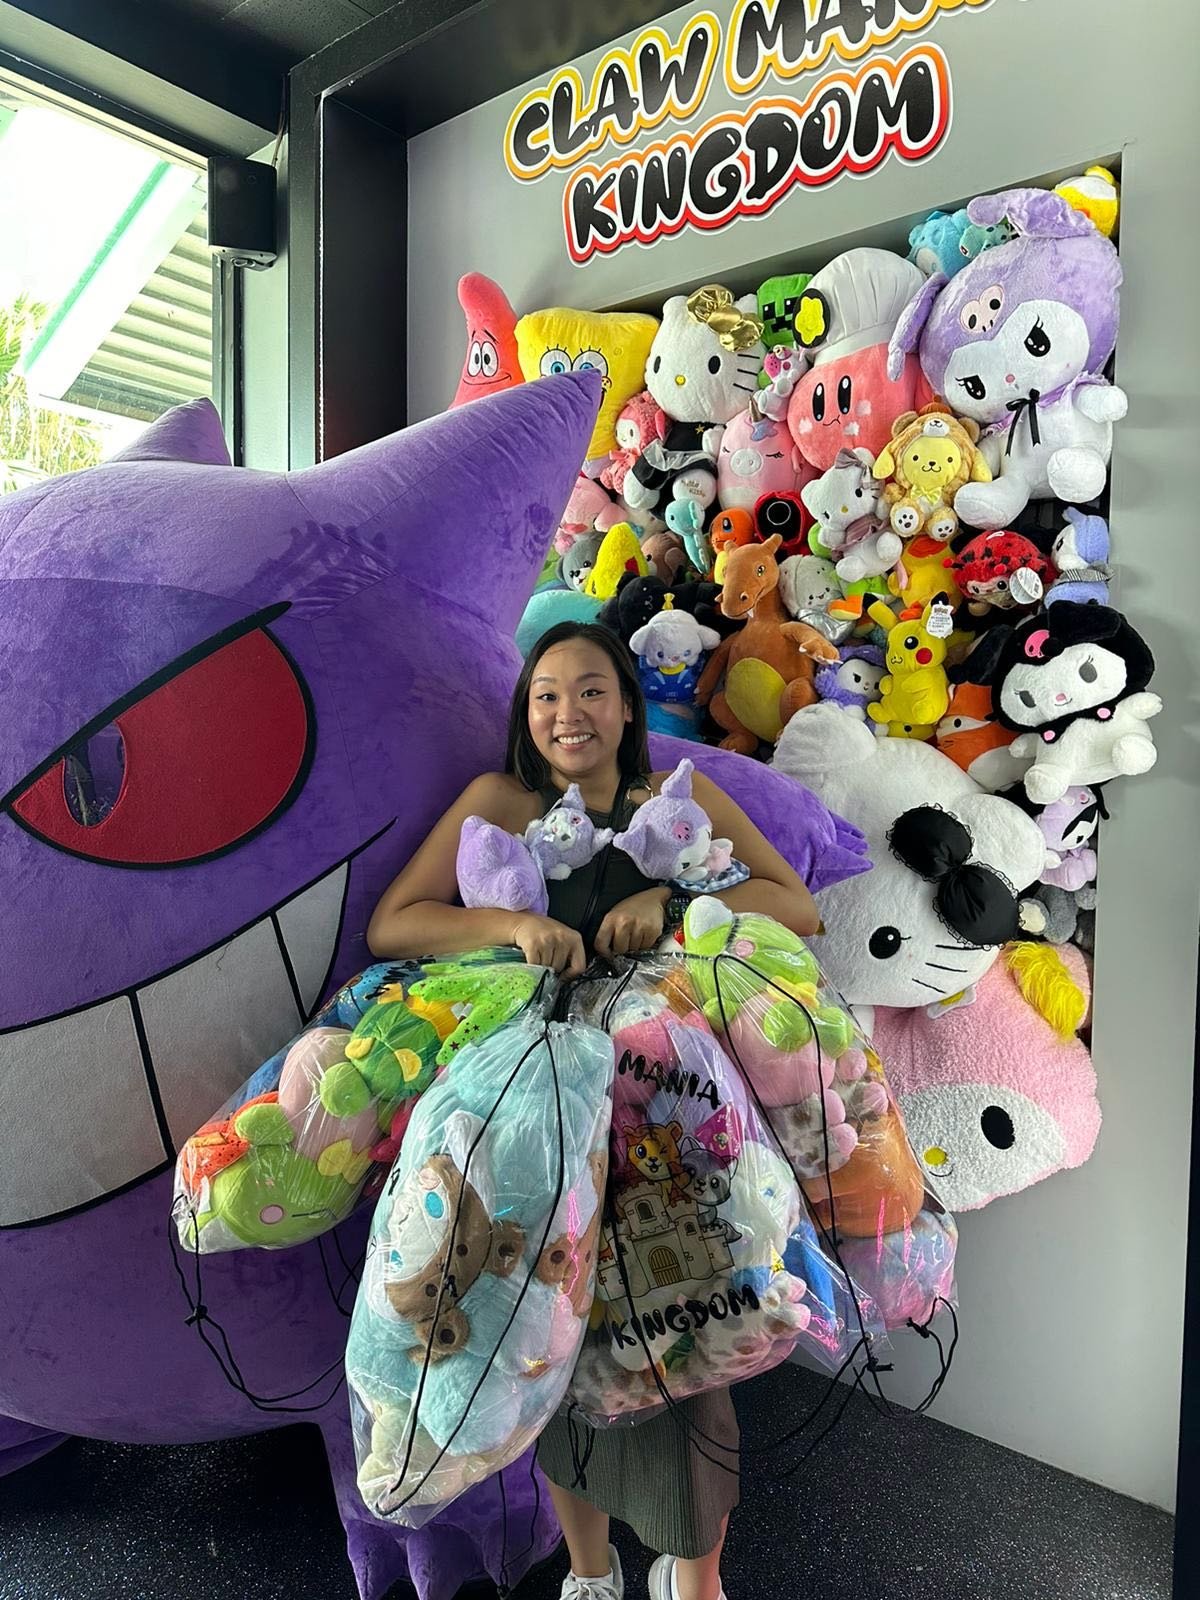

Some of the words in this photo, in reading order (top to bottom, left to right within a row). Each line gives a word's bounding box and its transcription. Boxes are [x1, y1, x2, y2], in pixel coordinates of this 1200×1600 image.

[513, 27, 708, 168] CLAW
[571, 59, 935, 250] KINGDOM
[618, 1048, 722, 1111] MANIA
[611, 1282, 761, 1350] KINGDOM
